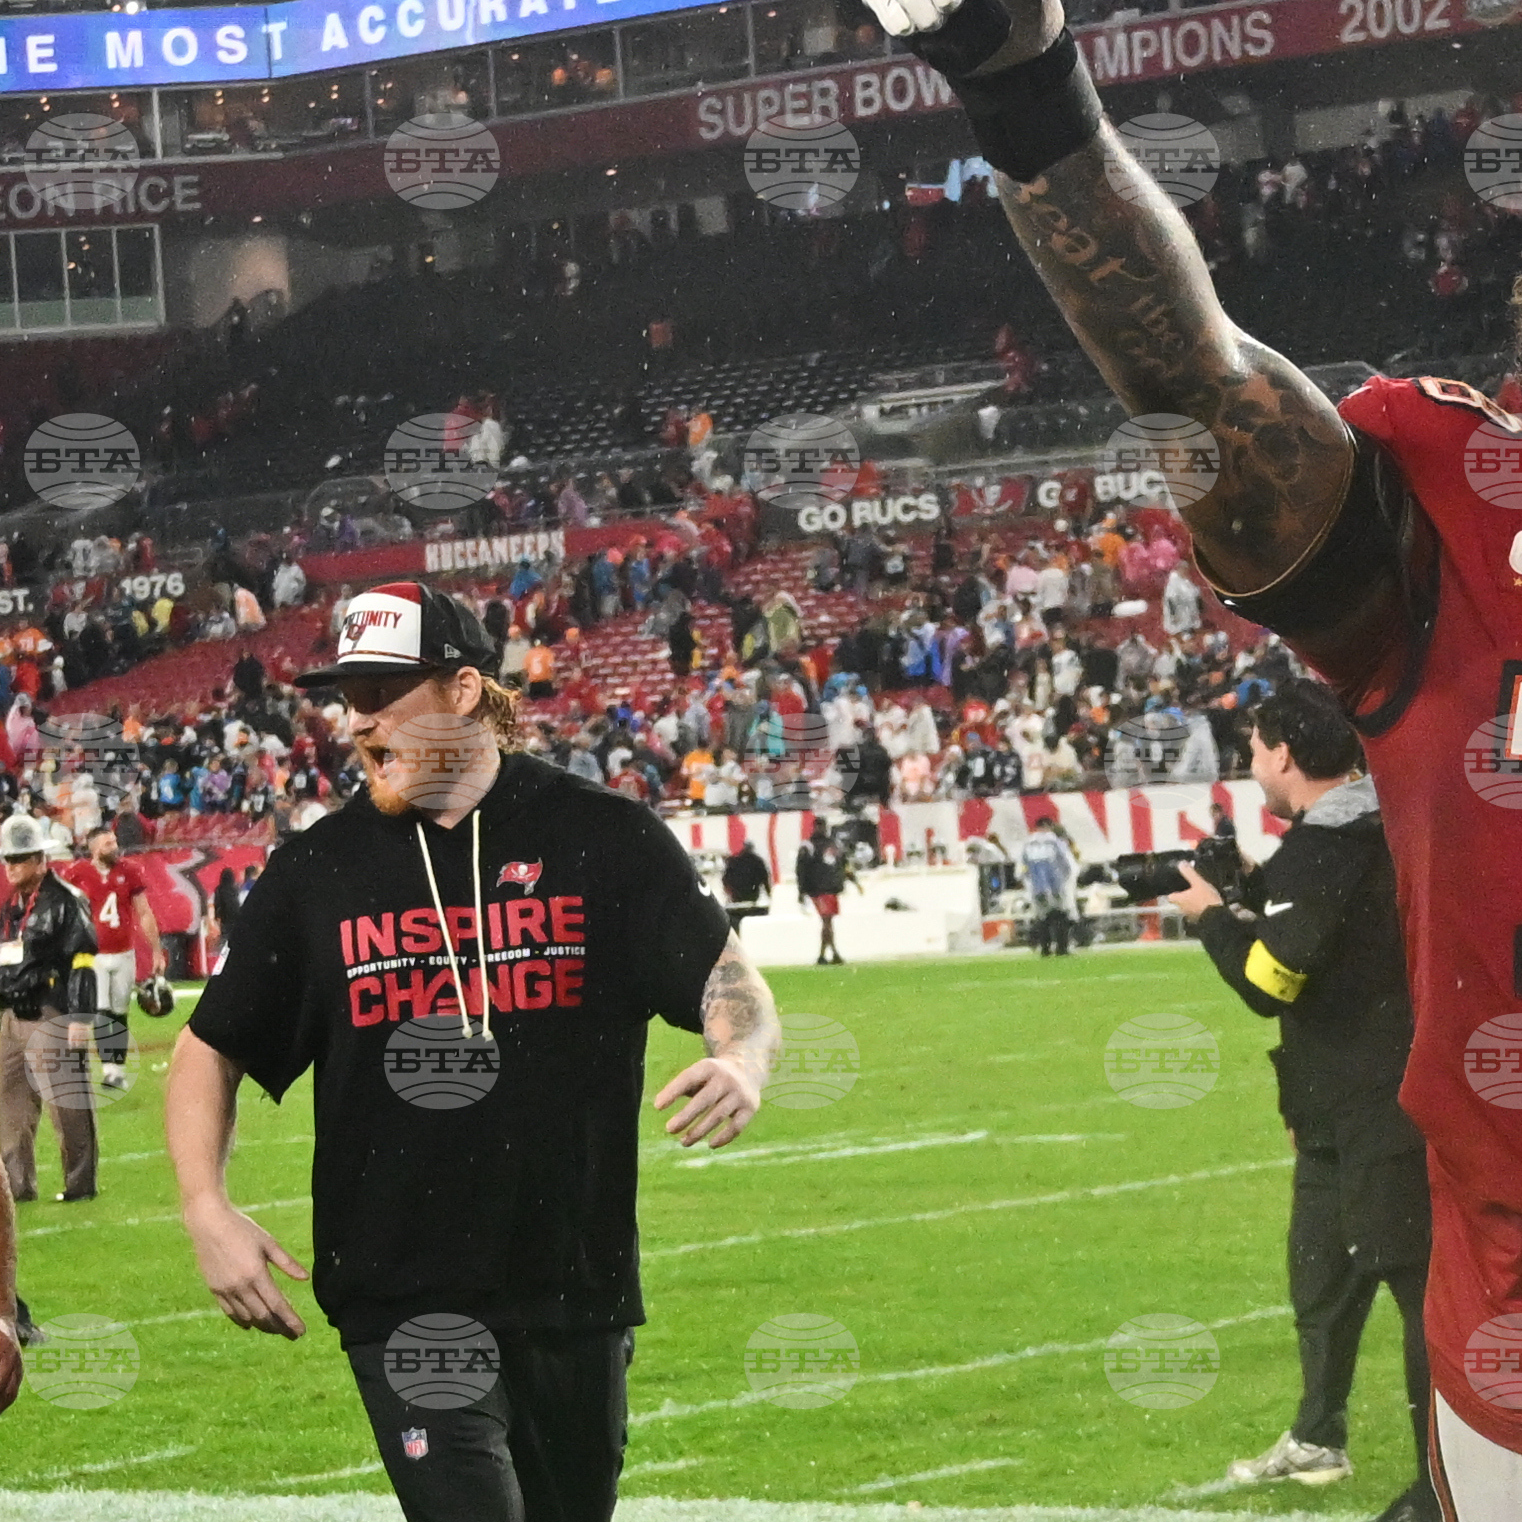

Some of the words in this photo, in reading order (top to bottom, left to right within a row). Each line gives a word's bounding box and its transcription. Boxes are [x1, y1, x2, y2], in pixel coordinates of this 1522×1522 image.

[105, 22, 288, 71] MOST
[698, 74, 840, 142] SUPER
[854, 50, 952, 120] BOW
[92, 175, 201, 215] RICE
[1094, 470, 1168, 502] BUC
[798, 504, 848, 534] GO
[120, 572, 186, 601] 1976
[98, 892, 121, 930] 4
[340, 896, 586, 966] INSPIRE
[347, 957, 416, 979] OPPORTUNITY
[428, 954, 468, 967] EQUTY
[543, 945, 587, 957] JUSTICE
[348, 958, 587, 1028] CHANGE
